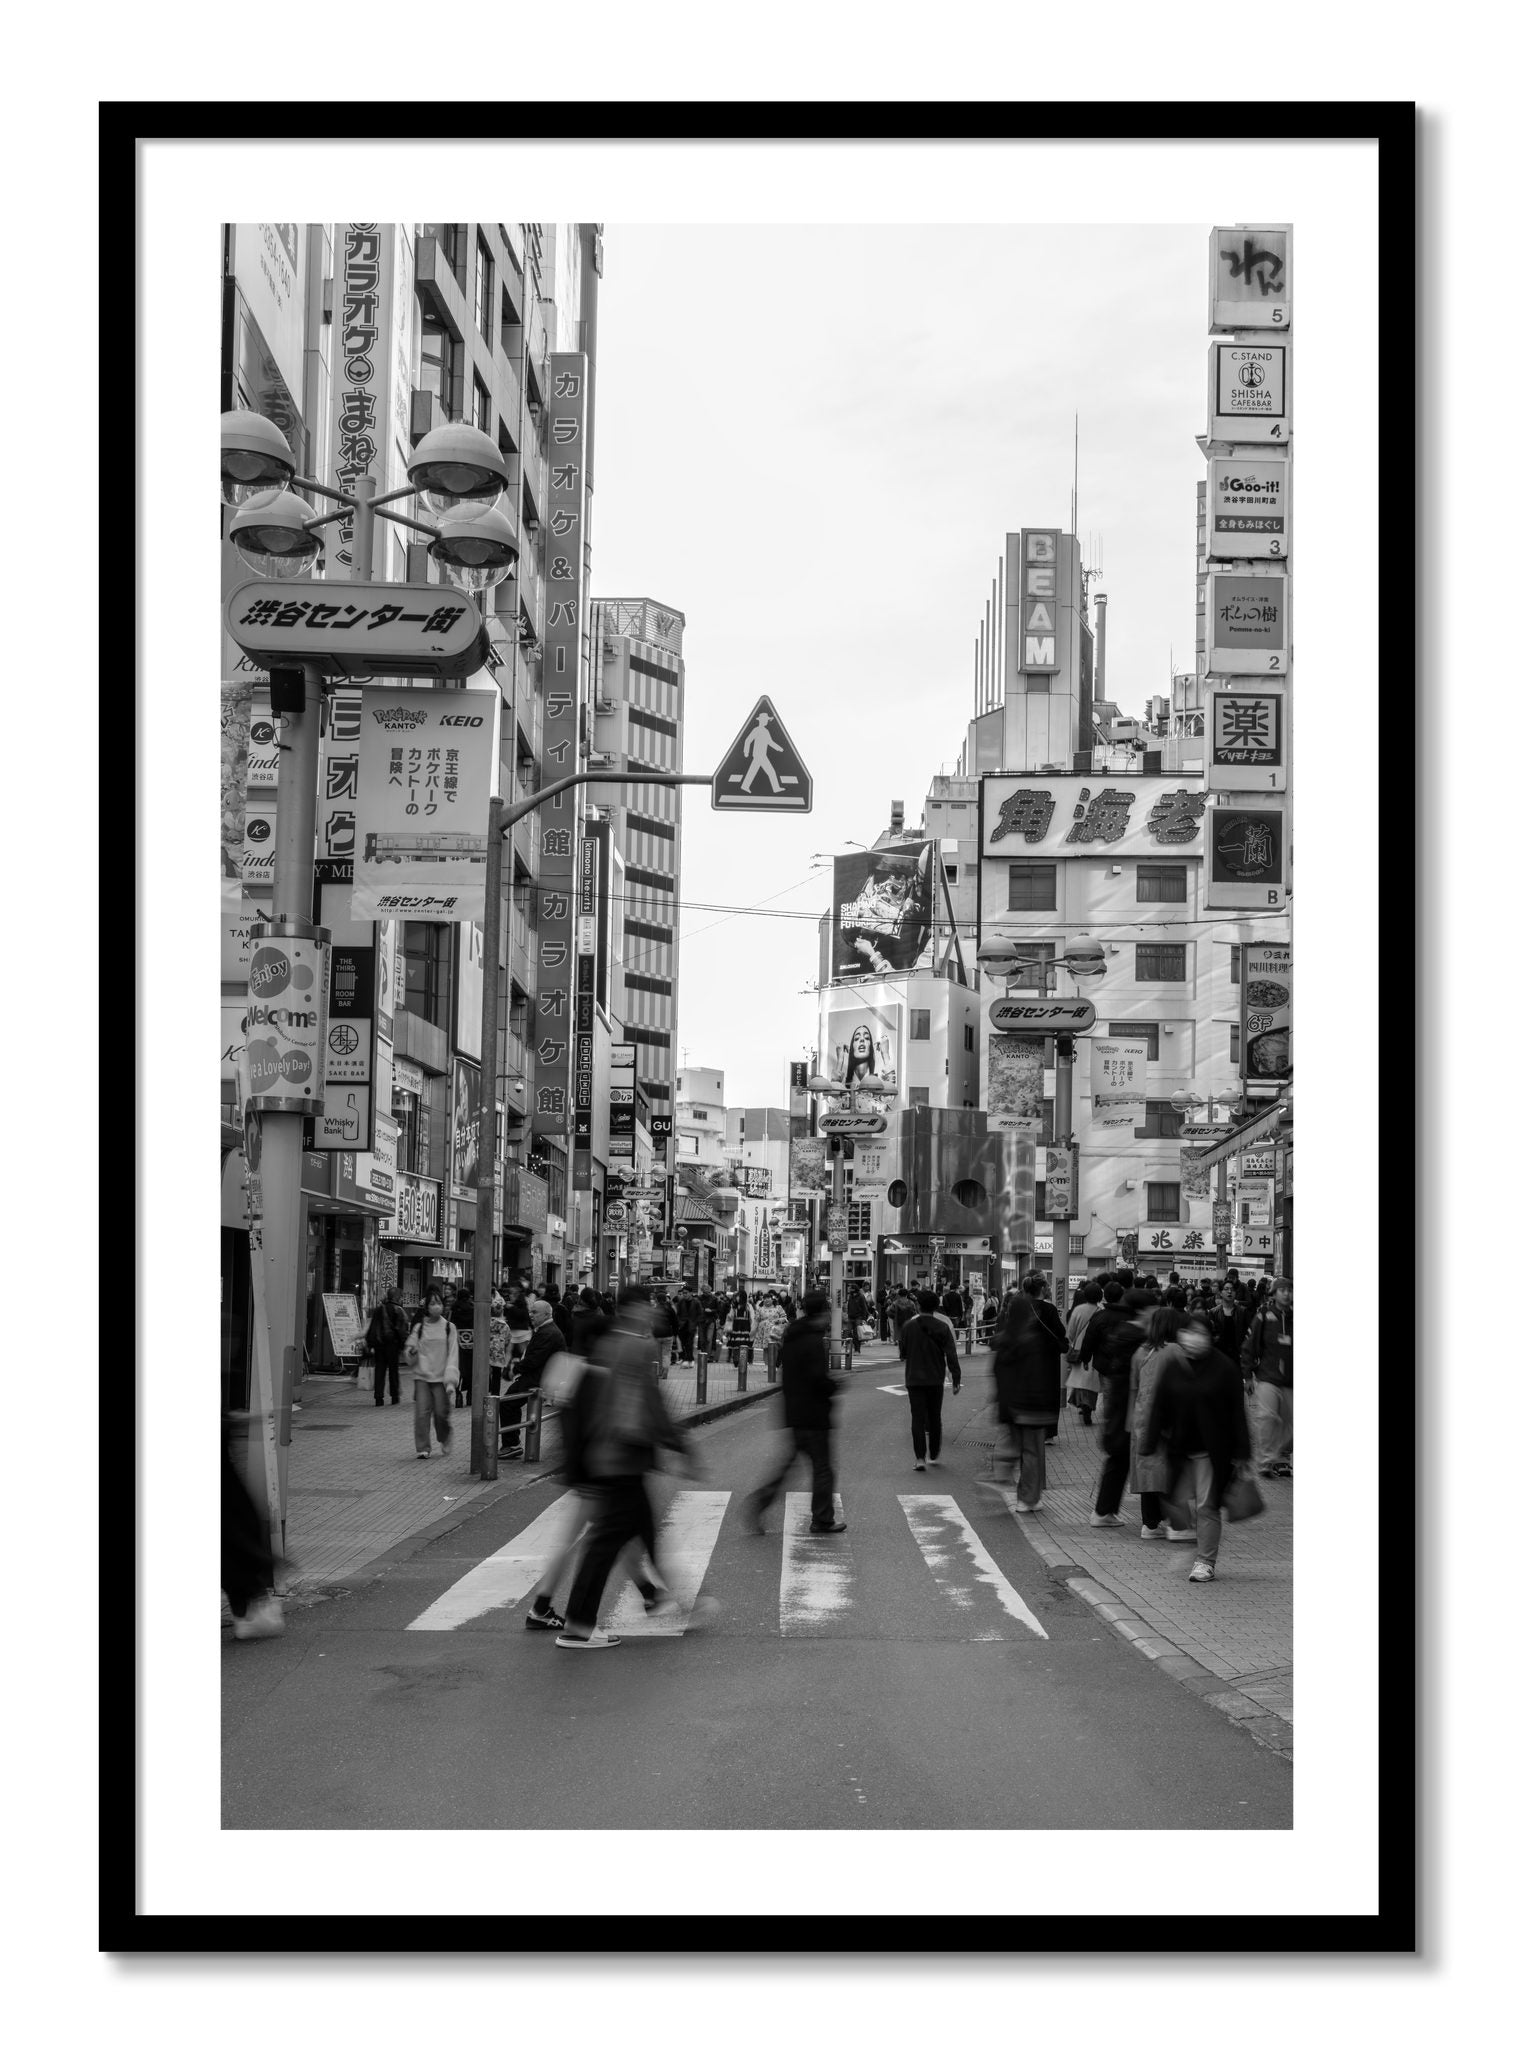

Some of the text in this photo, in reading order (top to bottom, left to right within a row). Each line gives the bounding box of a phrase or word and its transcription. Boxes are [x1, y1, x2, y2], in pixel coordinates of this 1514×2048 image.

[343, 232, 381, 358] カラオケ
[1272, 309, 1283, 322] 5
[1231, 352, 1272, 360] C.STAND
[1231, 389, 1272, 399] SHISHA
[1231, 399, 1272, 407] CAFE&BAR
[1270, 424, 1281, 438] 4
[1230, 478, 1280, 493] Goo-it!
[1219, 519, 1281, 530] 全身もみほぐし
[1269, 540, 1281, 555] 3
[1025, 534, 1056, 665] BEAM
[239, 598, 467, 634] 渋谷センター街
[1269, 656, 1280, 670] 2
[384, 722, 416, 730] KANTO
[439, 715, 484, 728] KEIO
[1223, 700, 1269, 747] 薬
[388, 747, 404, 787] 冒険へ
[251, 773, 274, 781] 渋谷店
[405, 747, 422, 816] カントーの
[424, 747, 441, 816] ポケパーク
[443, 748, 460, 803] 京王線で
[1268, 772, 1276, 788] 1
[990, 787, 1209, 844] 角海老
[247, 871, 270, 879] 渋谷店
[583, 842, 592, 911] kimono hearts
[377, 896, 459, 908] 渋谷センター街
[1267, 890, 1278, 904] B
[251, 959, 289, 991] Enjoy
[248, 1004, 318, 1028] Welcome
[996, 1006, 1090, 1018] 渋谷センター街
[1247, 1014, 1274, 1032] 6F
[263, 1057, 291, 1076] Lovely
[292, 1058, 311, 1071] Day!
[324, 1118, 355, 1128] Whisky
[324, 1126, 343, 1135] Bank
[653, 1121, 671, 1131] GU
[761, 1228, 769, 1267] BEER
